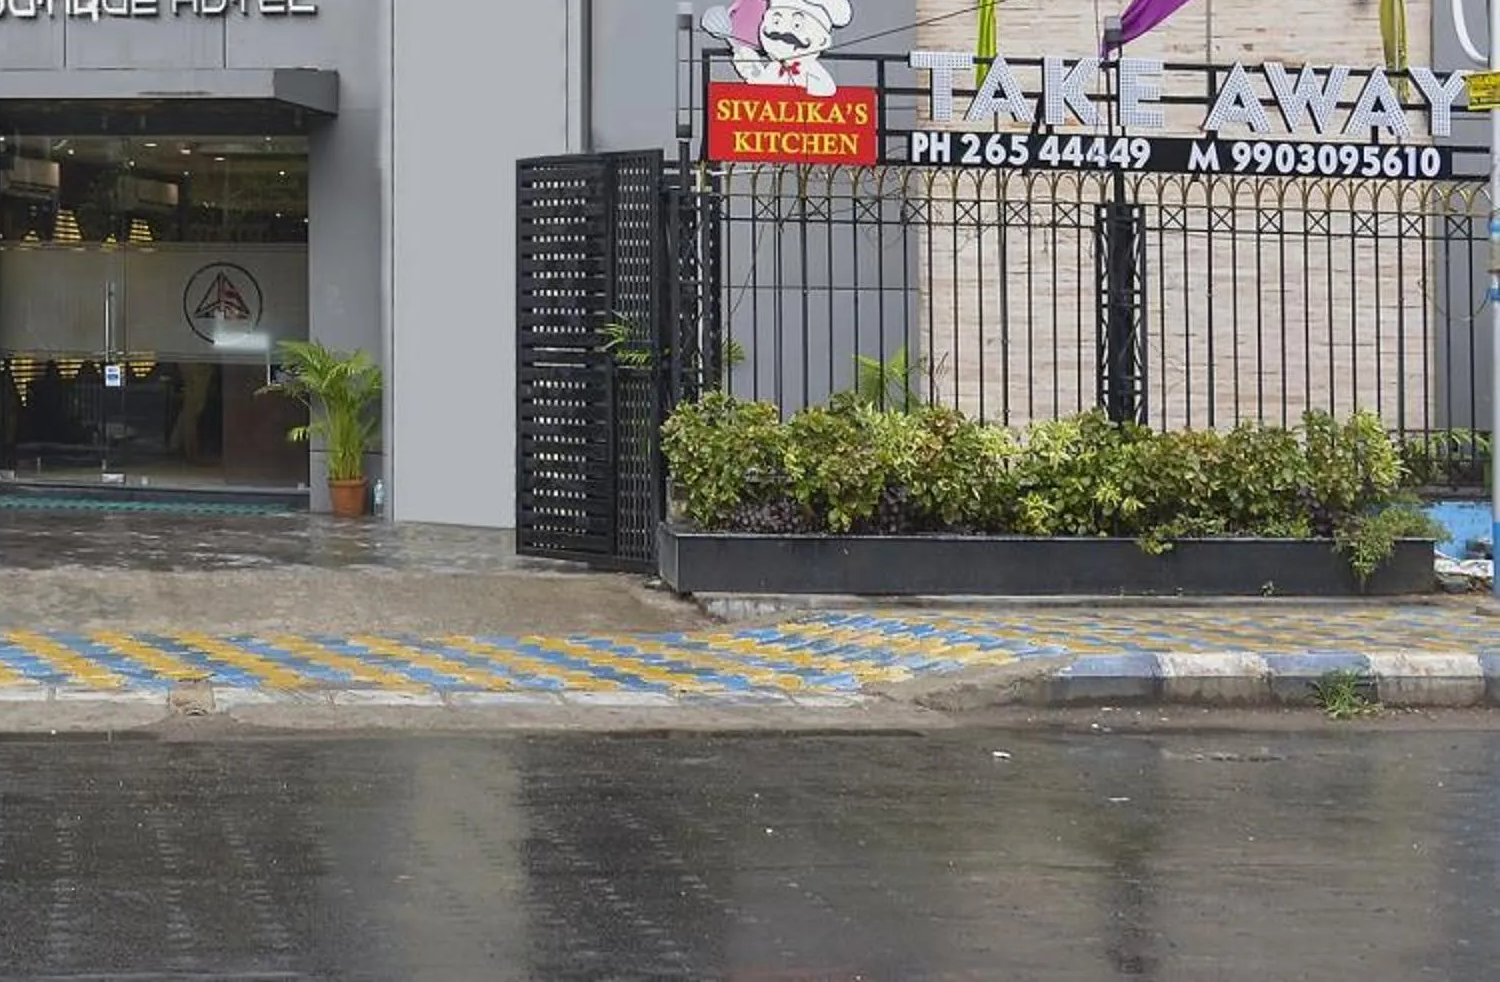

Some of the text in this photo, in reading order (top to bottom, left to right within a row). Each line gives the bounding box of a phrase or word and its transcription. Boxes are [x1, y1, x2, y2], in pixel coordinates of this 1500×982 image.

[909, 51, 1166, 128] TAKE
[1204, 60, 1468, 137] AWAY
[716, 99, 869, 127] SIVALIKA'S
[733, 130, 859, 156] KITCHEN
[911, 131, 951, 164] PH
[961, 133, 1030, 166] 265
[1187, 140, 1220, 171] M
[1231, 142, 1442, 177] 9903095610
